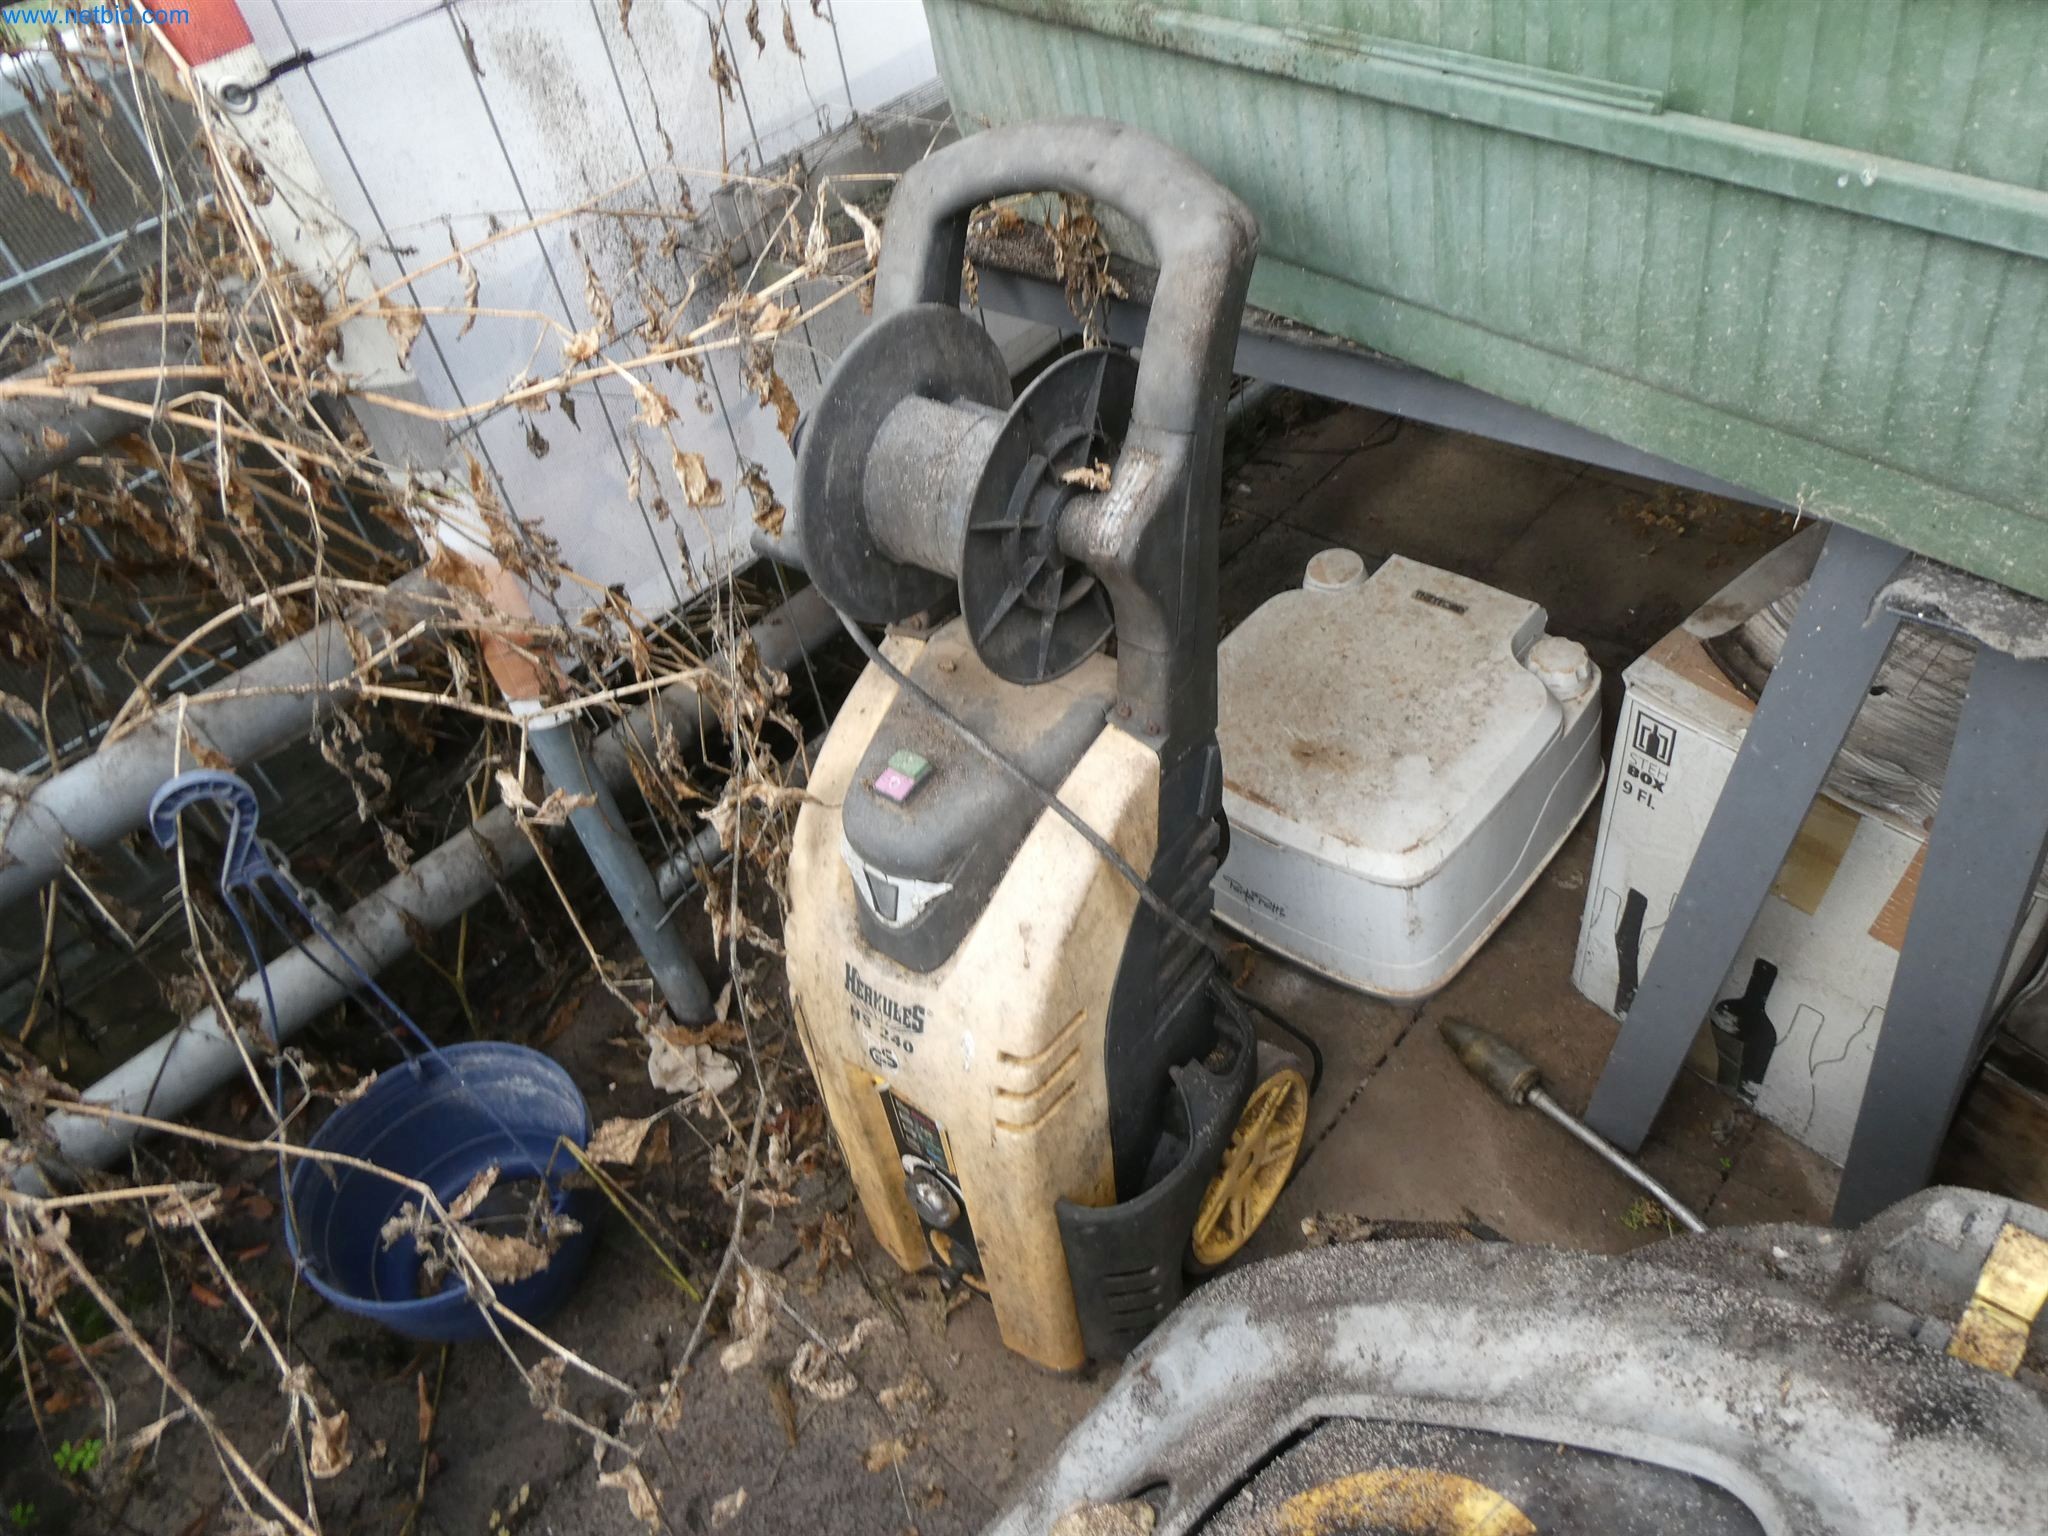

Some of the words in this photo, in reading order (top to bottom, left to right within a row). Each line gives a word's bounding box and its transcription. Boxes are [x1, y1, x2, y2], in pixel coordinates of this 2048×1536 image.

[1627, 763, 1664, 794] BOX
[1629, 751, 1669, 782] STEH
[1622, 780, 1633, 795] 9
[845, 961, 925, 1034] HERKULES
[850, 1003, 871, 1029] HS
